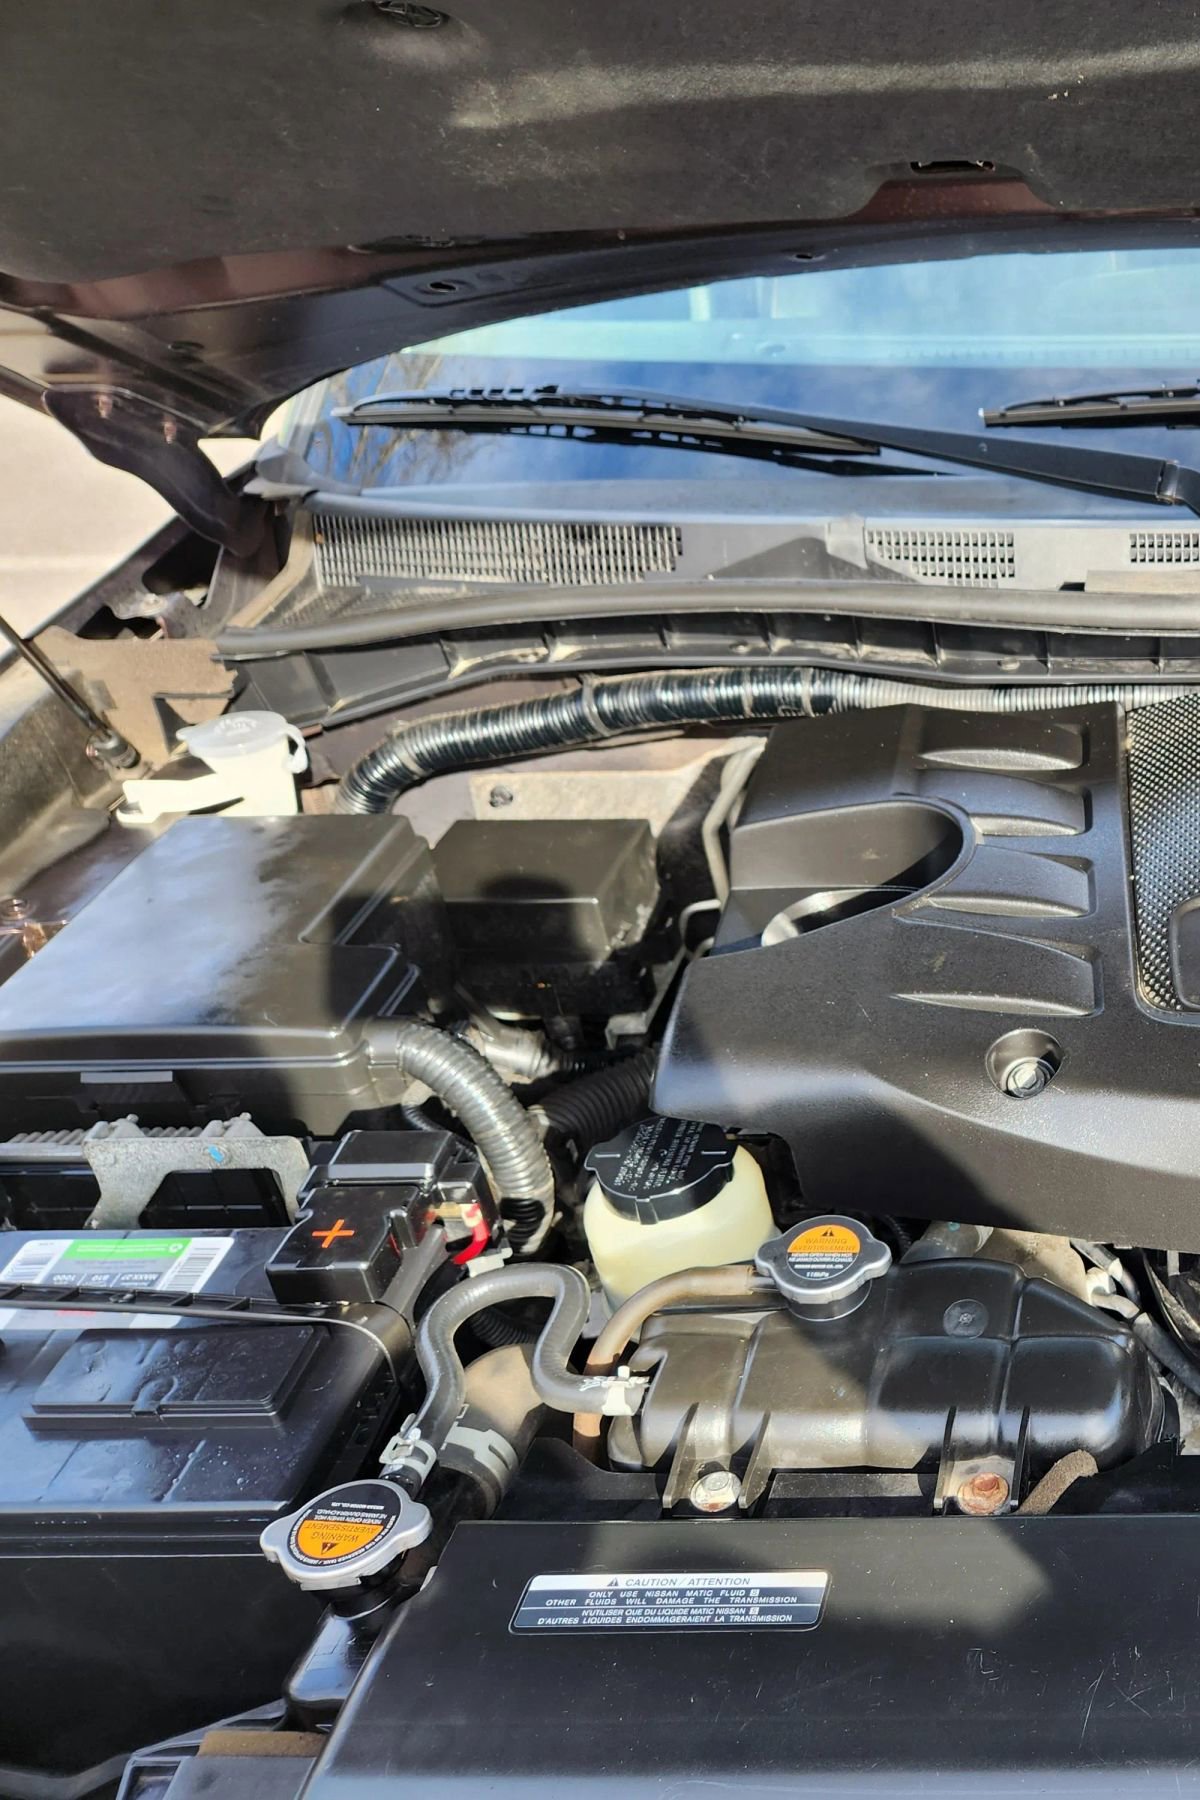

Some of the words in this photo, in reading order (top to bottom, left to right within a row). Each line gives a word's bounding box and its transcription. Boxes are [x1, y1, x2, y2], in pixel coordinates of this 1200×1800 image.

[305, 1523, 376, 1533] AVERTISSEMENT
[311, 1532, 359, 1543] WARNING
[625, 1578, 678, 1587] CAUTION
[687, 1577, 751, 1586] ATTENTION
[585, 1598, 617, 1606] FLUIDS
[730, 1596, 797, 1604] TRANSMISSION
[537, 1617, 579, 1625] D'AUTRES
[582, 1616, 622, 1624] LIQUIDES
[625, 1615, 710, 1623] ENDOMMAGERAIENT
[729, 1614, 793, 1622] TRANSMISSION
